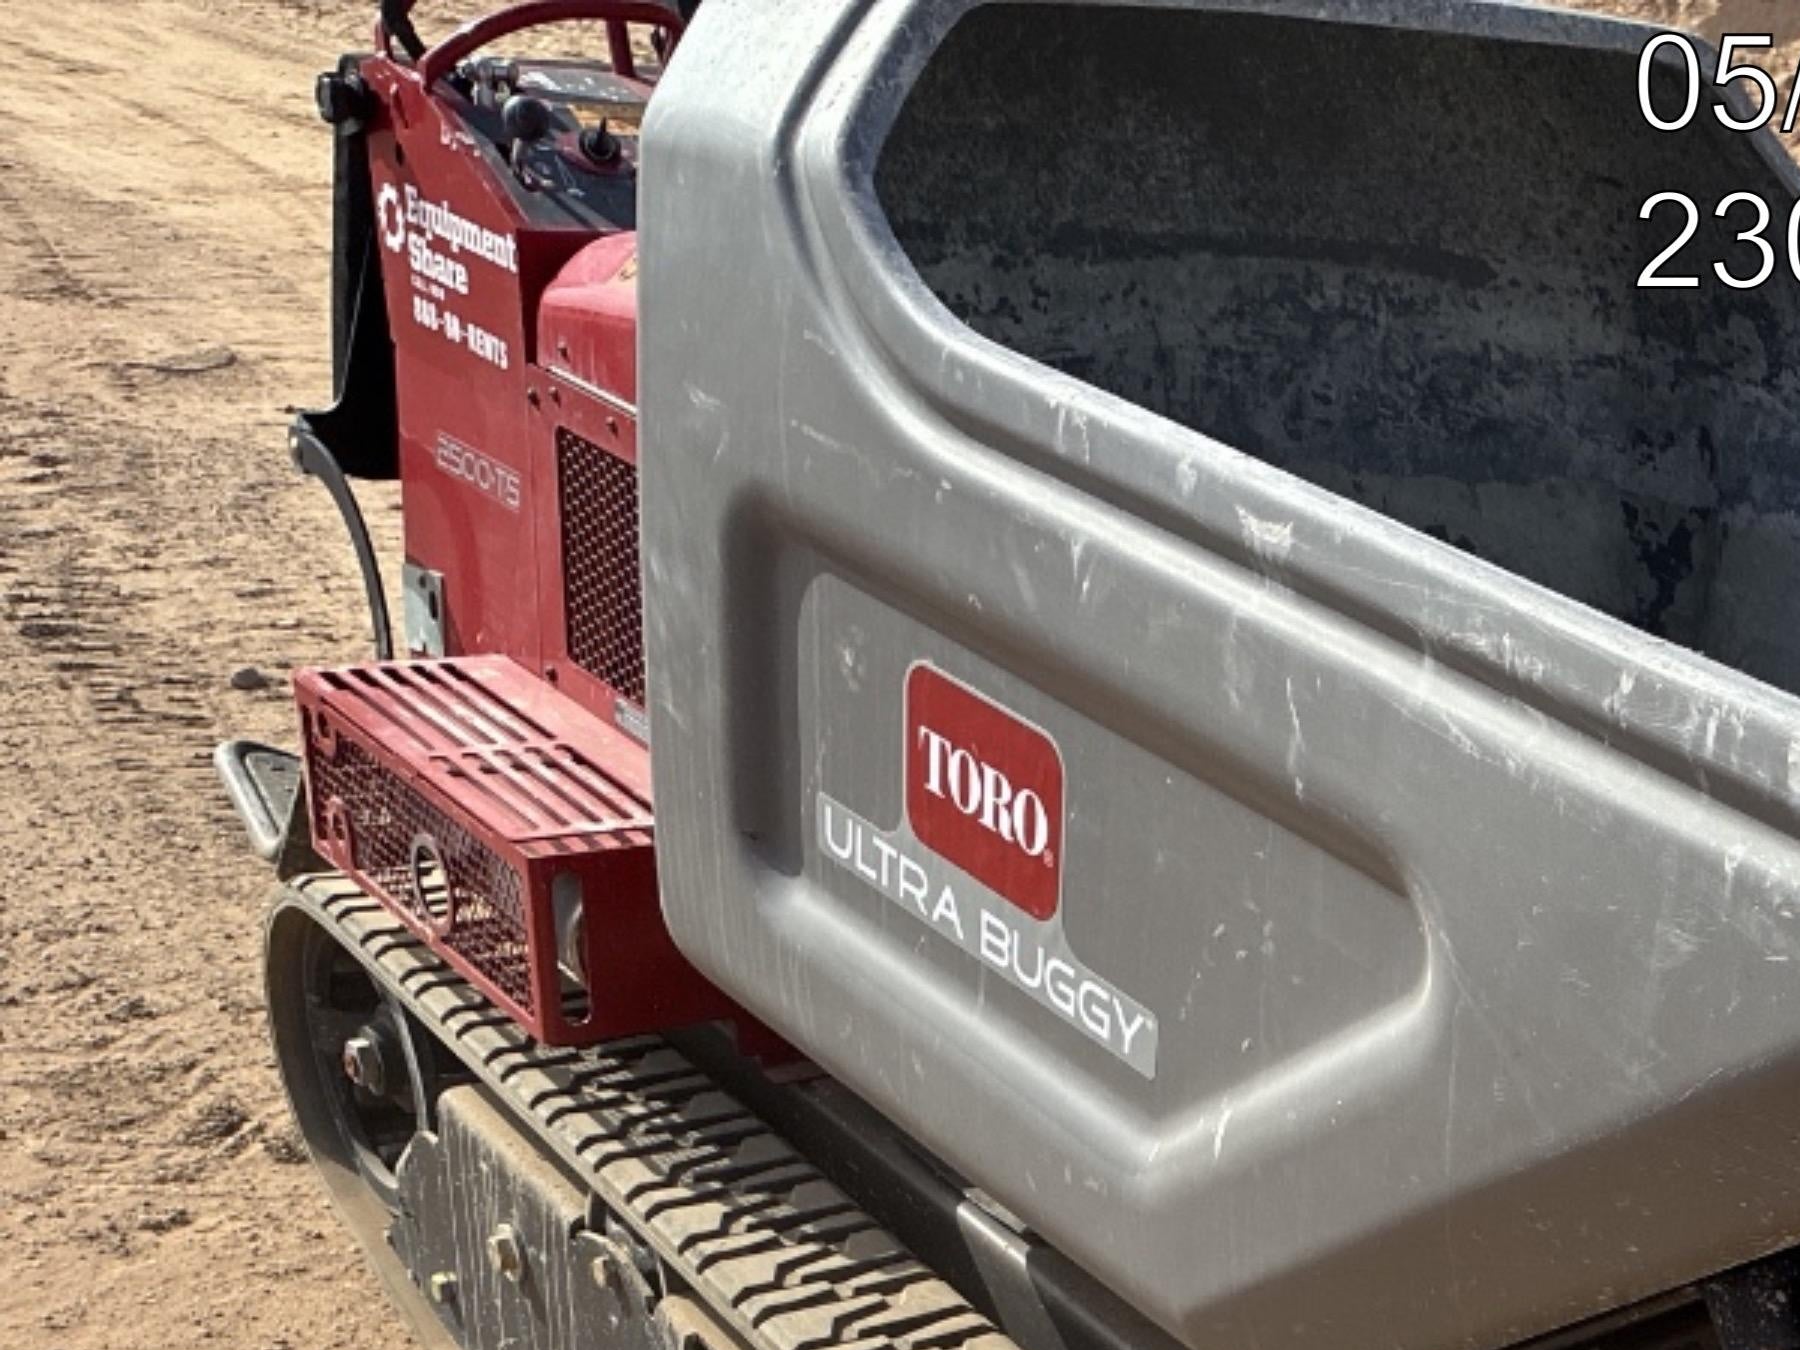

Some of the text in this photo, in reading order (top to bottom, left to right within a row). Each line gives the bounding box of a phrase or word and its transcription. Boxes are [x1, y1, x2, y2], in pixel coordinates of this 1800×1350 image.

[404, 183, 518, 273] Equipment
[407, 230, 469, 295] Share
[918, 725, 1050, 859] TORO
[823, 805, 1146, 1056] ULTRA BUGGY
